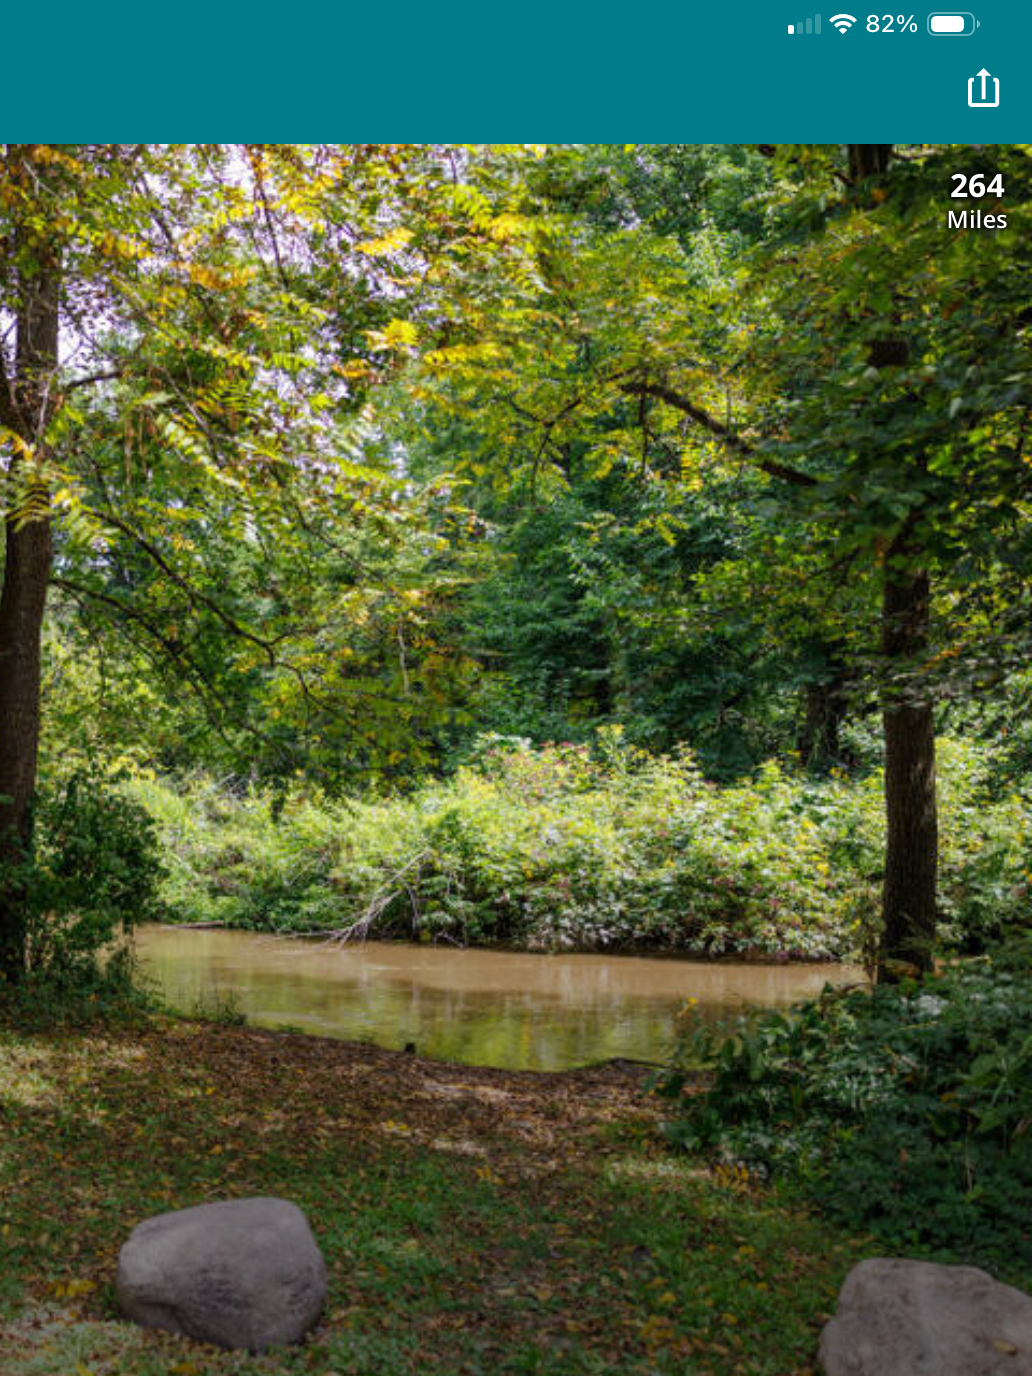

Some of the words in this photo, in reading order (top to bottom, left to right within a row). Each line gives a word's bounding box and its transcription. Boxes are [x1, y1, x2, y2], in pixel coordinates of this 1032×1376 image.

[865, 14, 918, 33] 82%
[950, 173, 1005, 198] 264
[947, 209, 1008, 229] Miles
